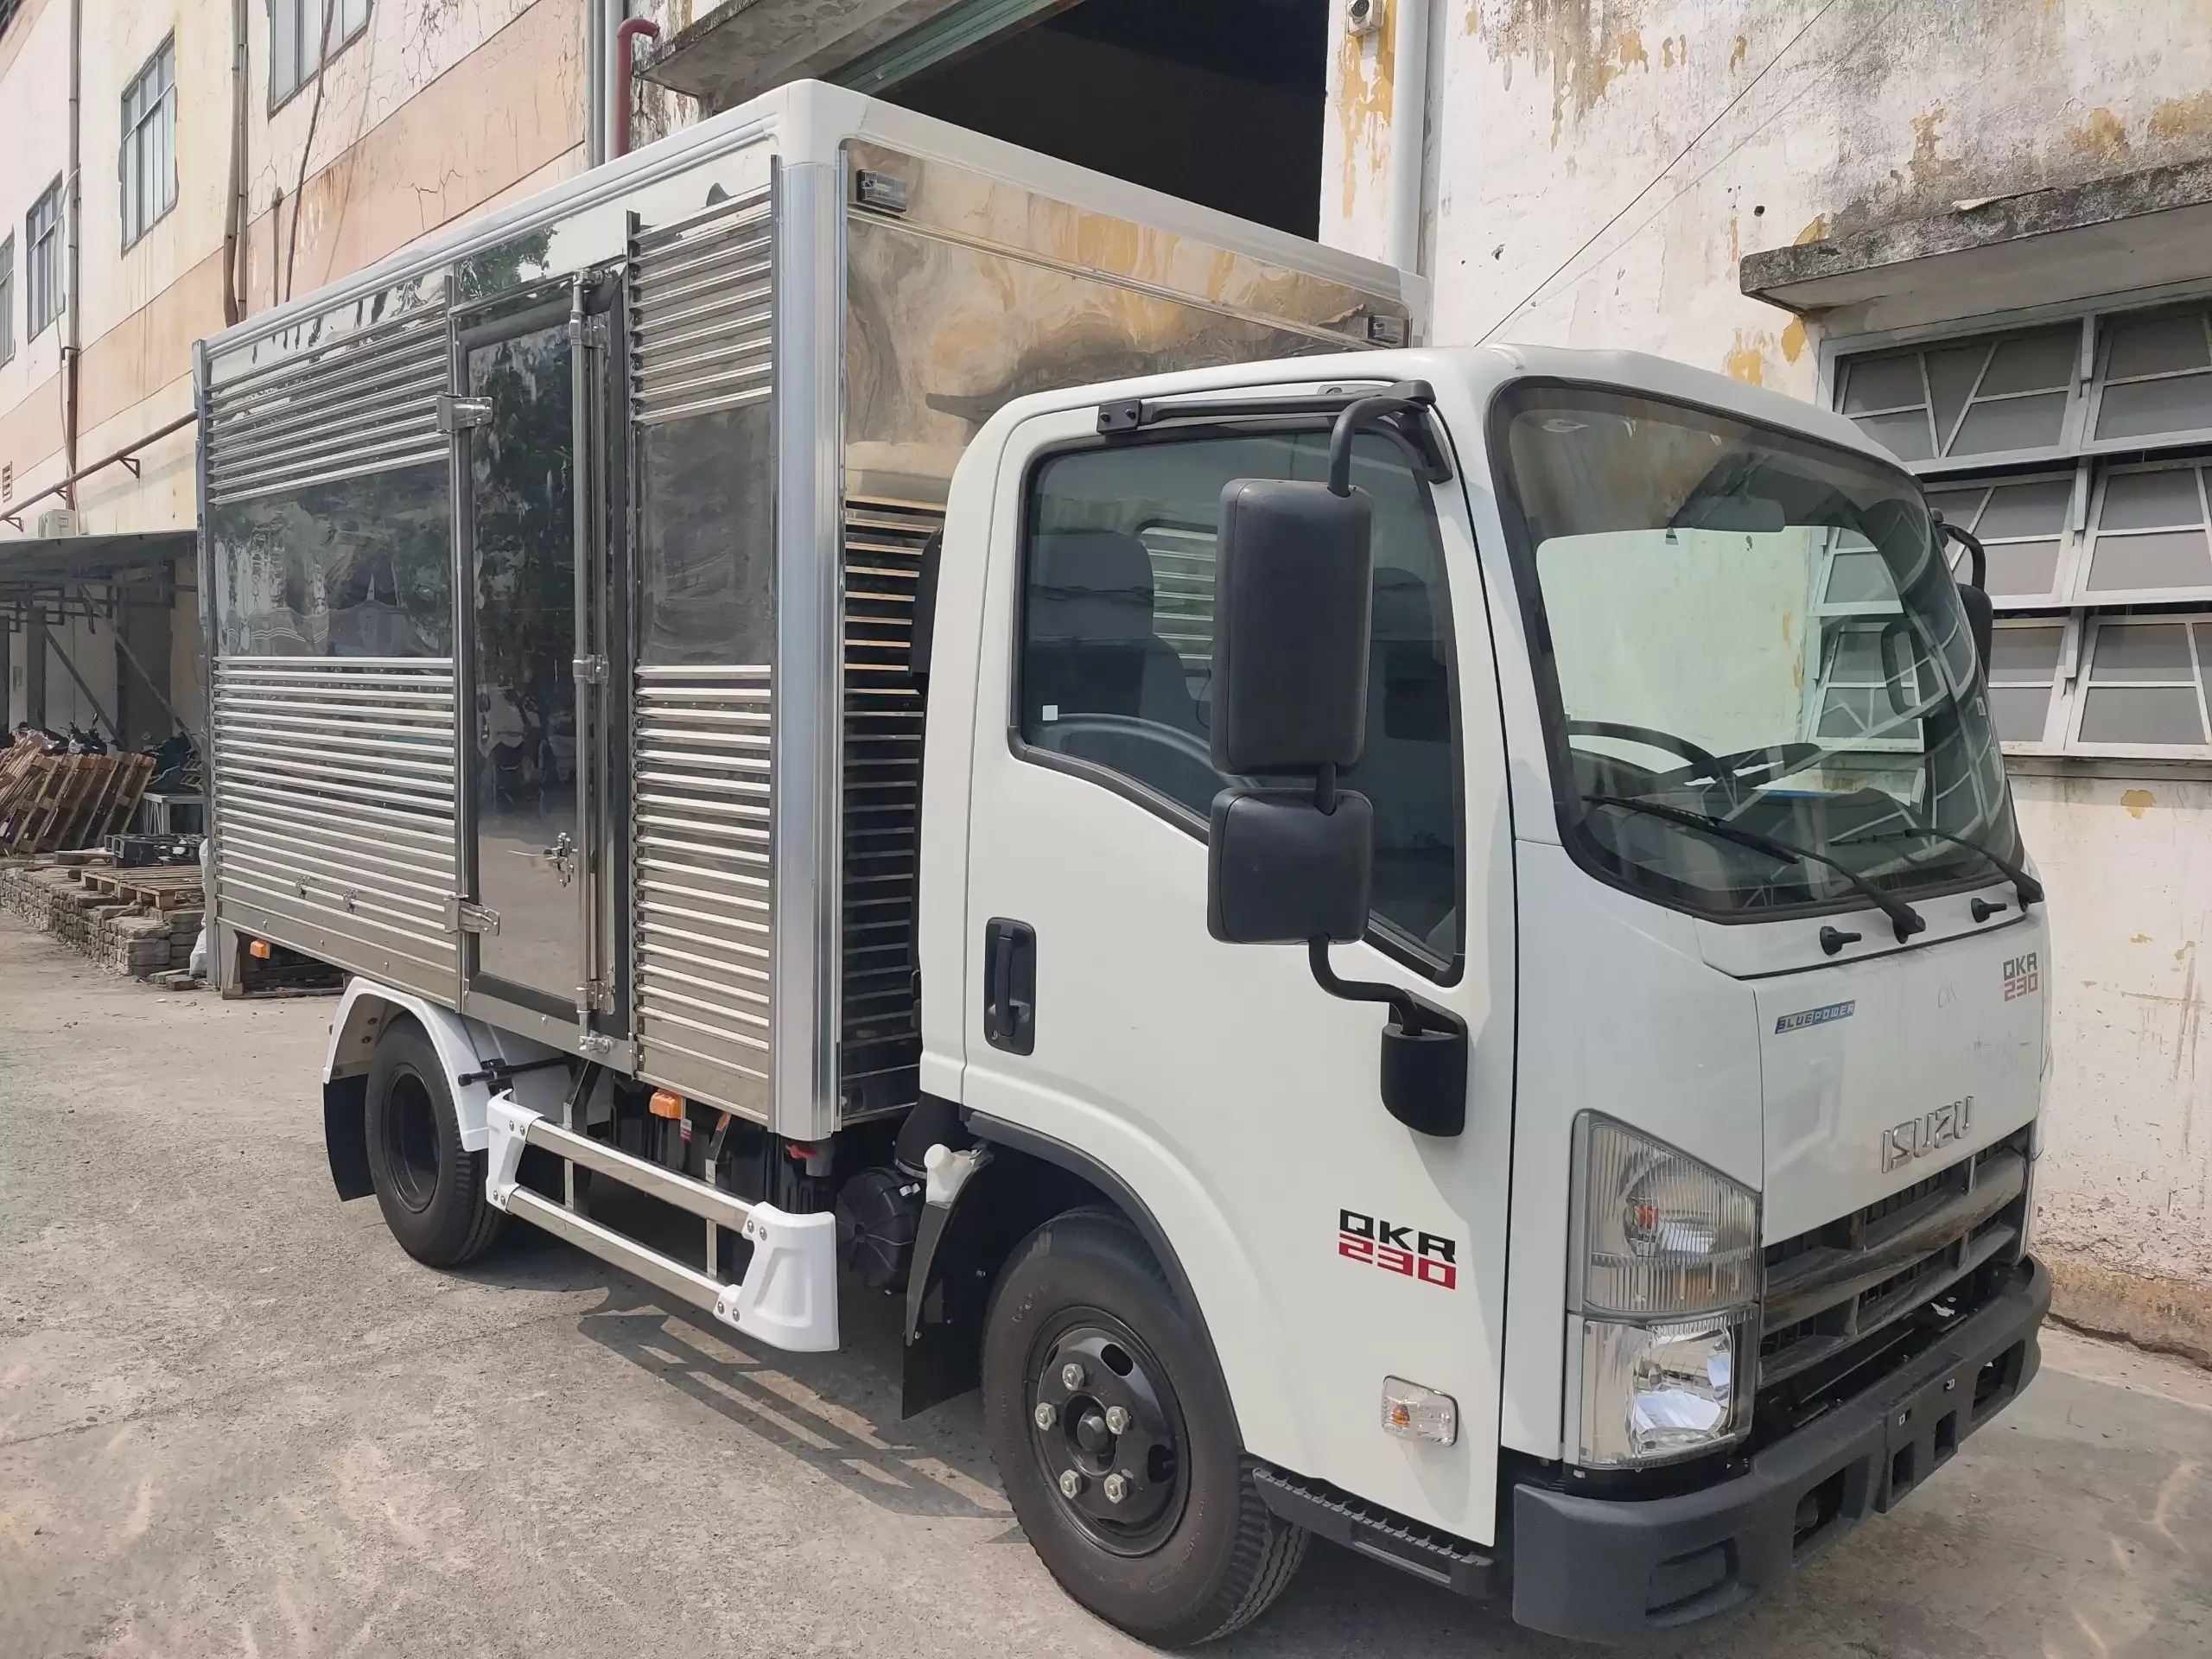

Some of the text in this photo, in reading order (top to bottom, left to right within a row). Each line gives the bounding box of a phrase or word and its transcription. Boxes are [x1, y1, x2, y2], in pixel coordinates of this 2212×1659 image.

[2004, 972, 2038, 1001] 230
[1882, 1096, 1974, 1173] ISUZU
[1339, 1208, 1457, 1264] QKR
[1339, 1232, 1457, 1290] 230
